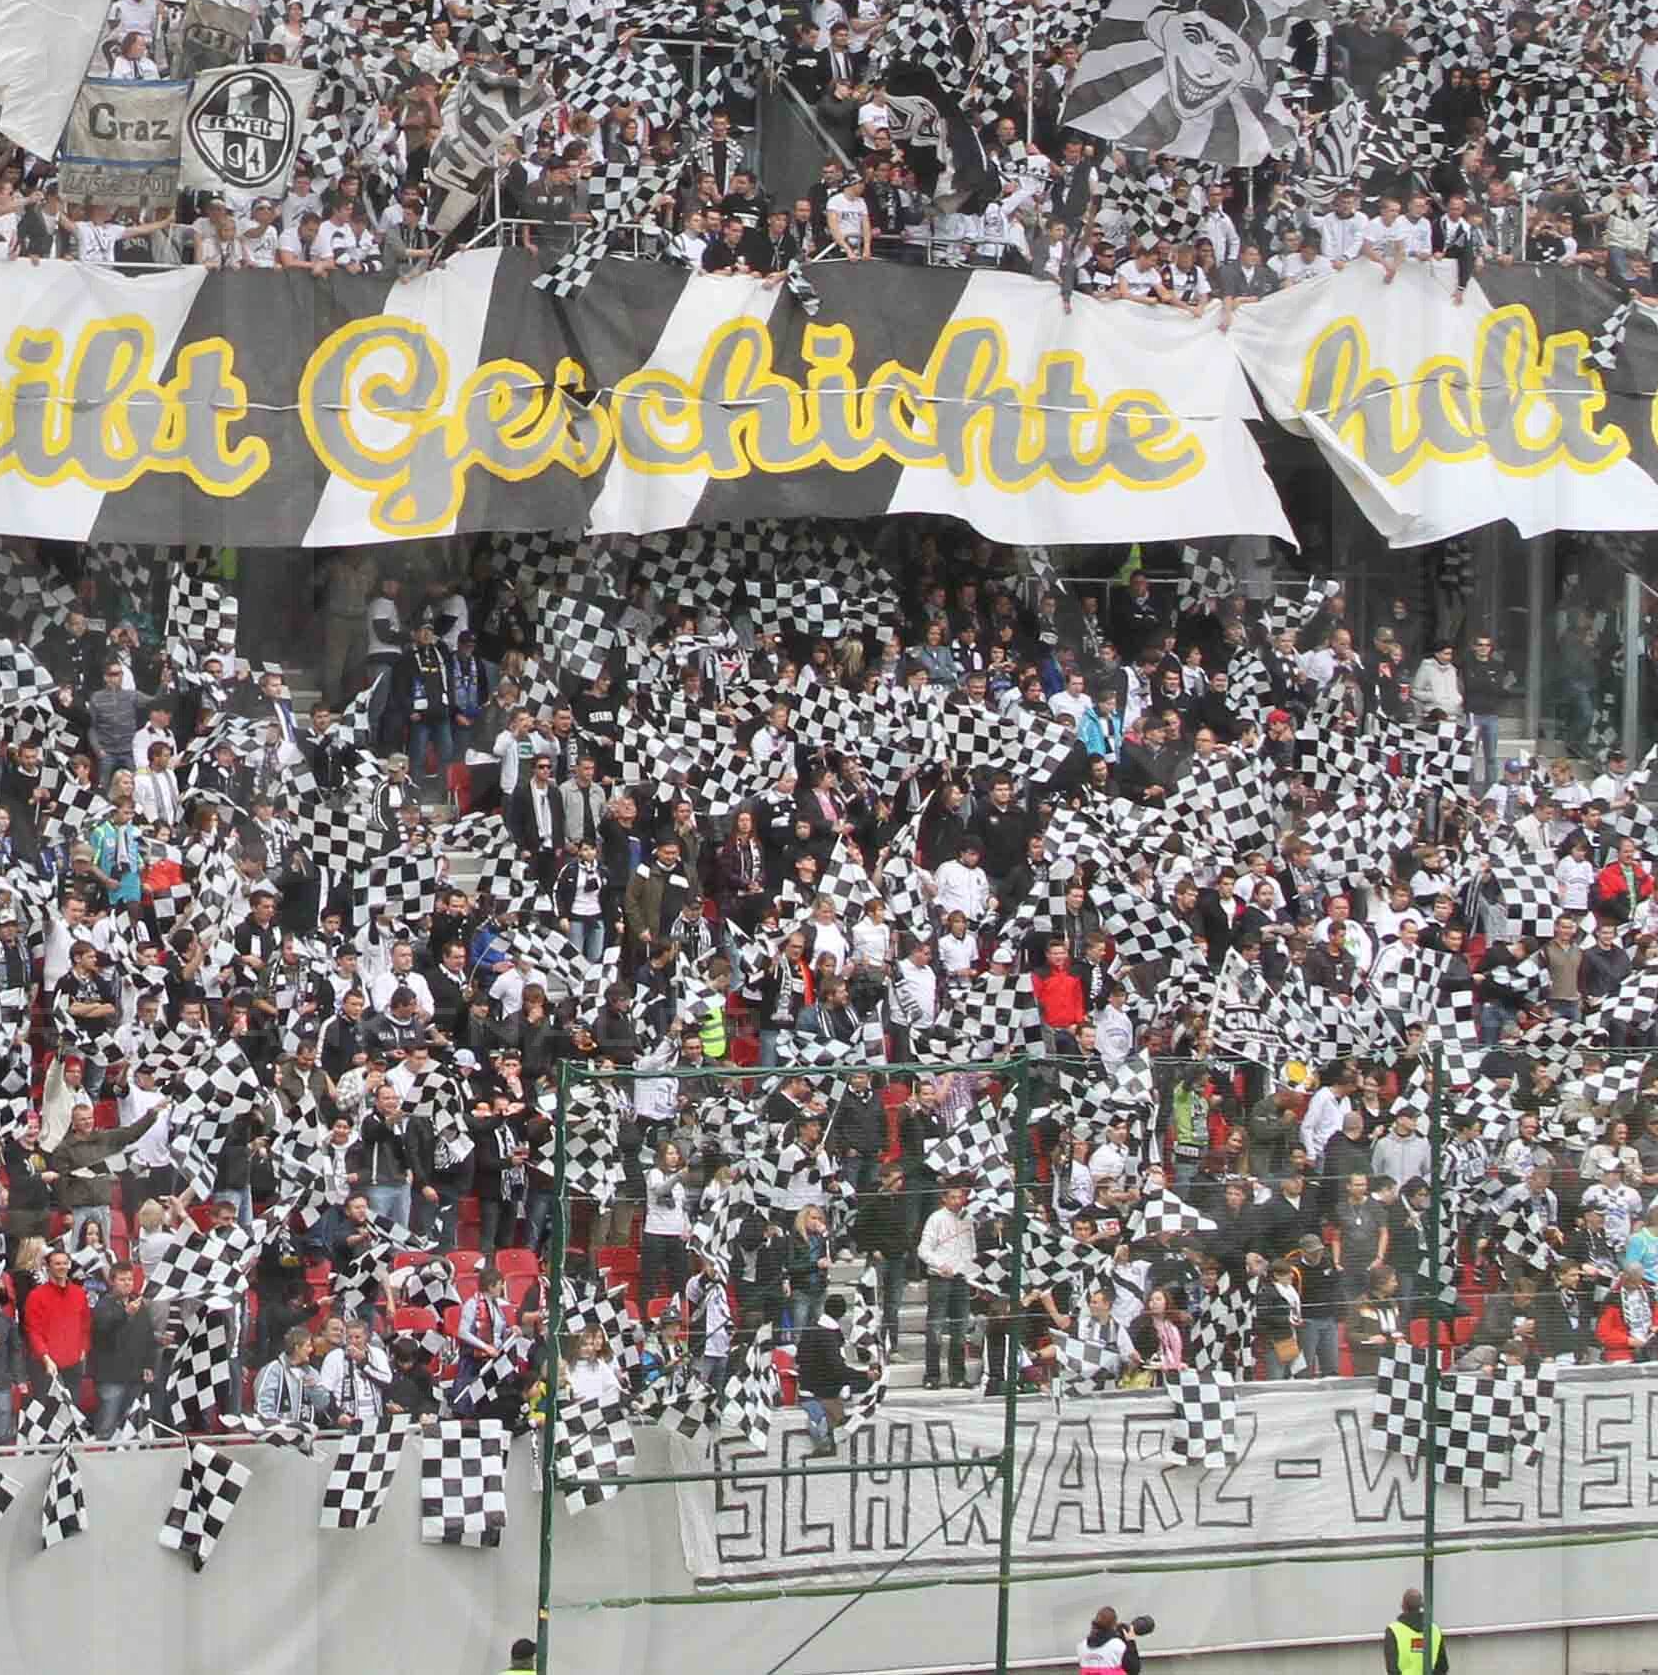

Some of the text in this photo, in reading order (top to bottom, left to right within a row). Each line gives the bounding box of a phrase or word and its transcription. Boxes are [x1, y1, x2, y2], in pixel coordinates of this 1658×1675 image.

[89, 103, 171, 141] Graz
[227, 143, 261, 171] 94
[296, 313, 1207, 537] Geschichte
[1300, 303, 1630, 486] holt
